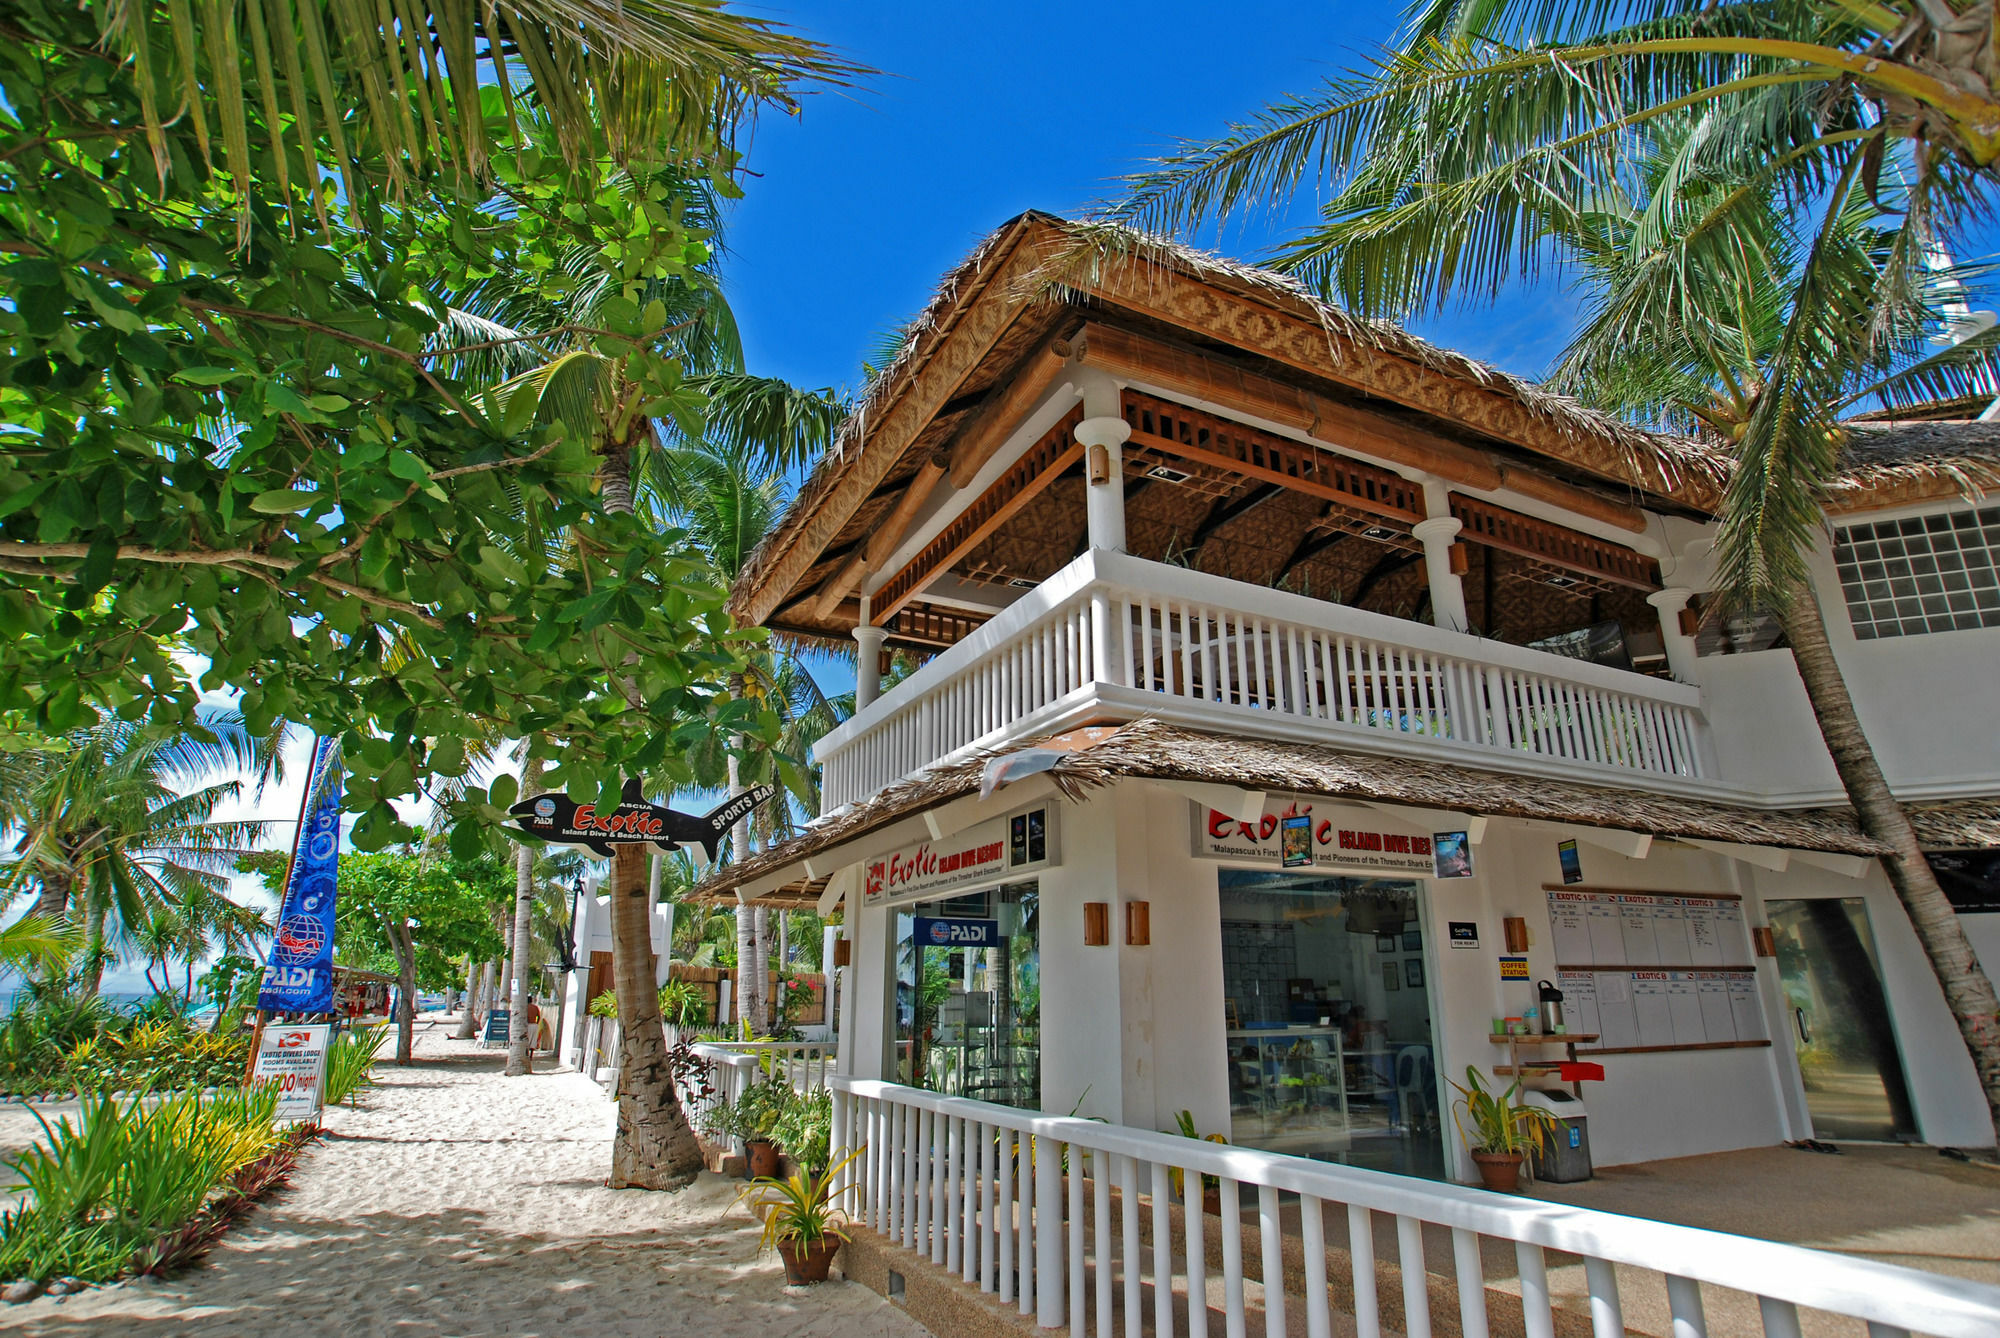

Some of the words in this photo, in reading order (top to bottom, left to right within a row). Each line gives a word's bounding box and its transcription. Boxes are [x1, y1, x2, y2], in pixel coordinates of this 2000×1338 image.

[712, 796, 752, 830] SPORTS
[753, 783, 775, 802] BAR
[533, 817, 553, 825] PADI
[573, 804, 662, 835] Exotic
[562, 828, 587, 836] Island
[1338, 830, 1382, 851] ISLAND
[1383, 834, 1410, 854] DIVE
[1263, 848, 1279, 857] First
[889, 844, 938, 888] Exotic
[939, 853, 960, 874] ISLAND
[961, 849, 976, 869] DIVE
[977, 841, 1003, 865] RESORT
[1333, 854, 1360, 863] Pioneers
[1369, 856, 1378, 864] the
[1380, 857, 1406, 866] Thresher
[1556, 892, 1581, 901] EXOTIC
[1583, 893, 1588, 901] 1
[1625, 896, 1647, 904] EXOTIC
[951, 925, 987, 941] PADI
[261, 965, 315, 987] PADI
[260, 987, 311, 995] padi.com
